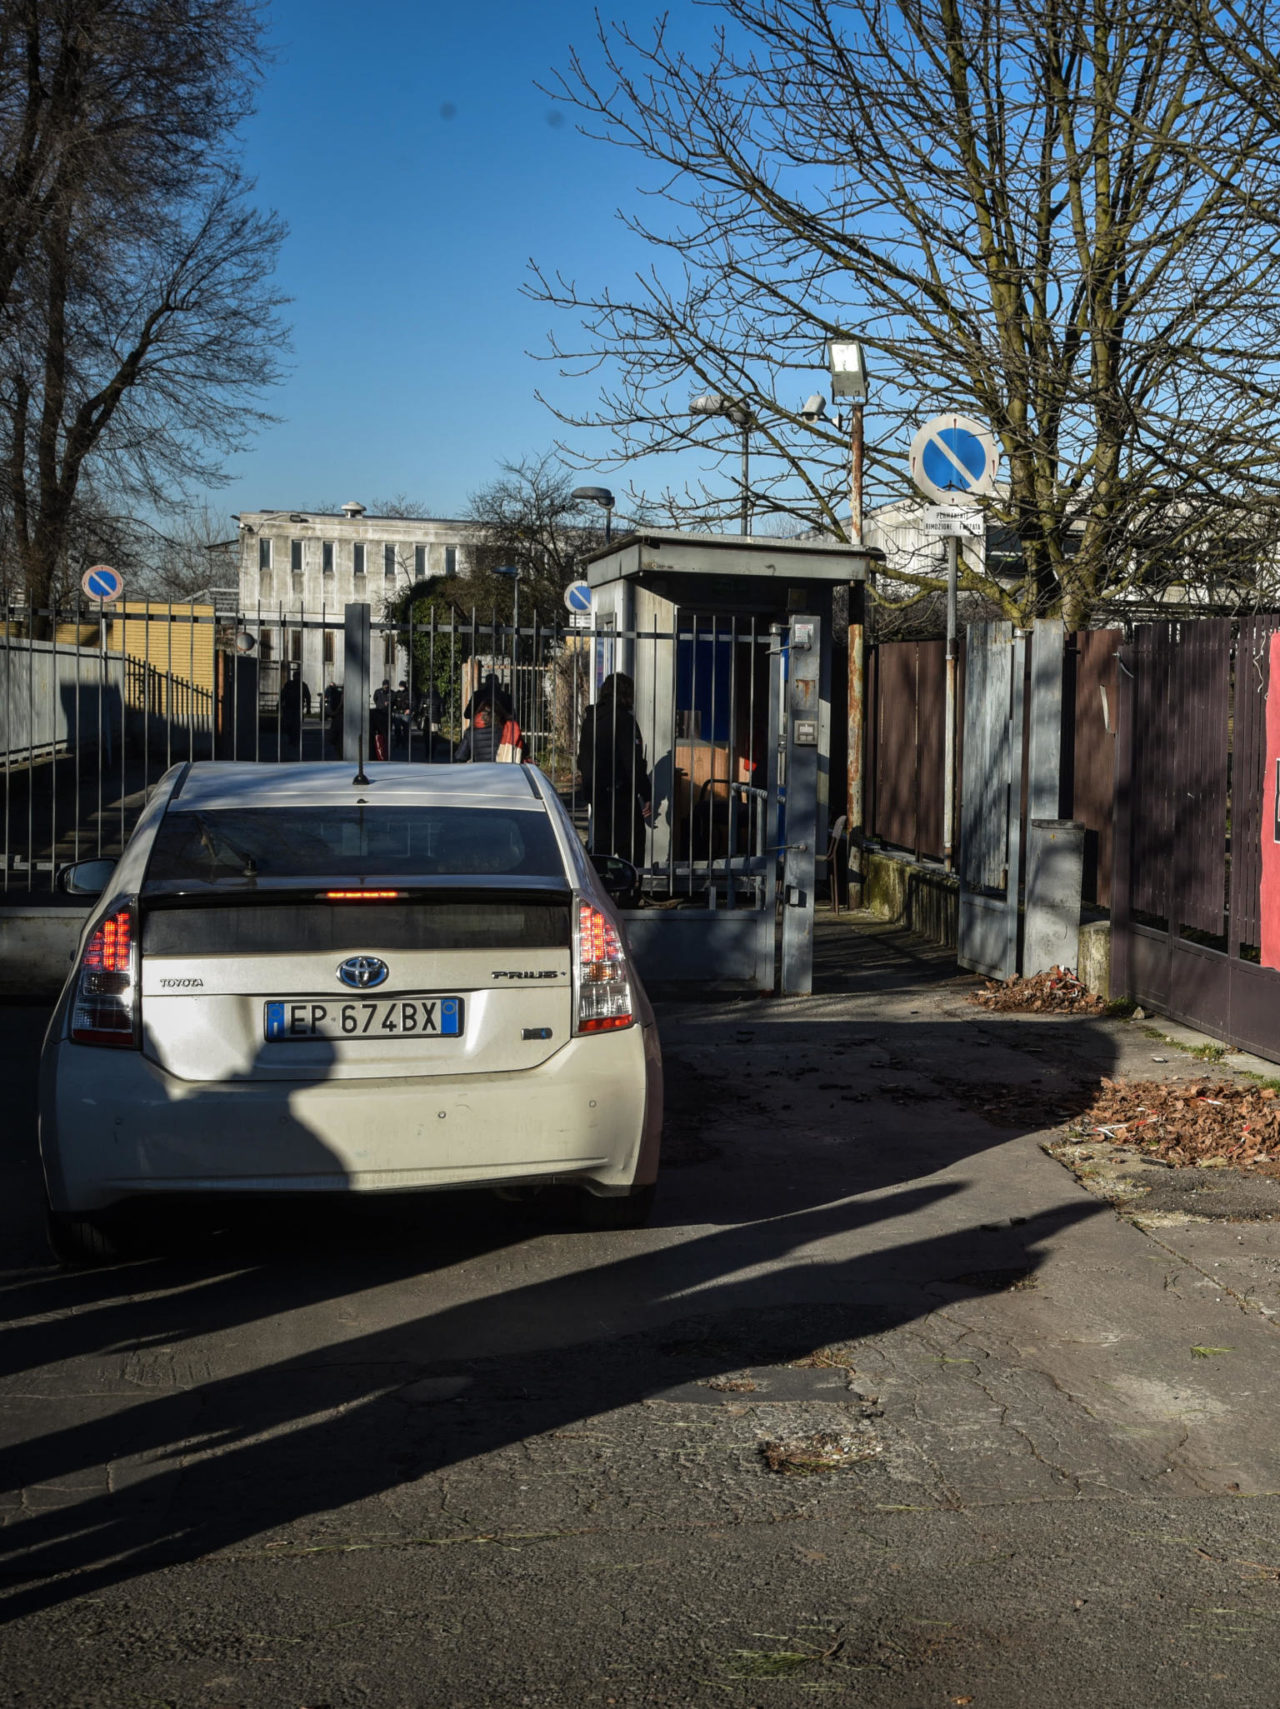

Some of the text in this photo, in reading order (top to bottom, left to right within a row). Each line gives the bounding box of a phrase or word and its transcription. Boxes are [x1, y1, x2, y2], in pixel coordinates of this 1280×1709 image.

[160, 978, 204, 988] TOYOTA
[290, 1002, 437, 1035] EP 674BX
